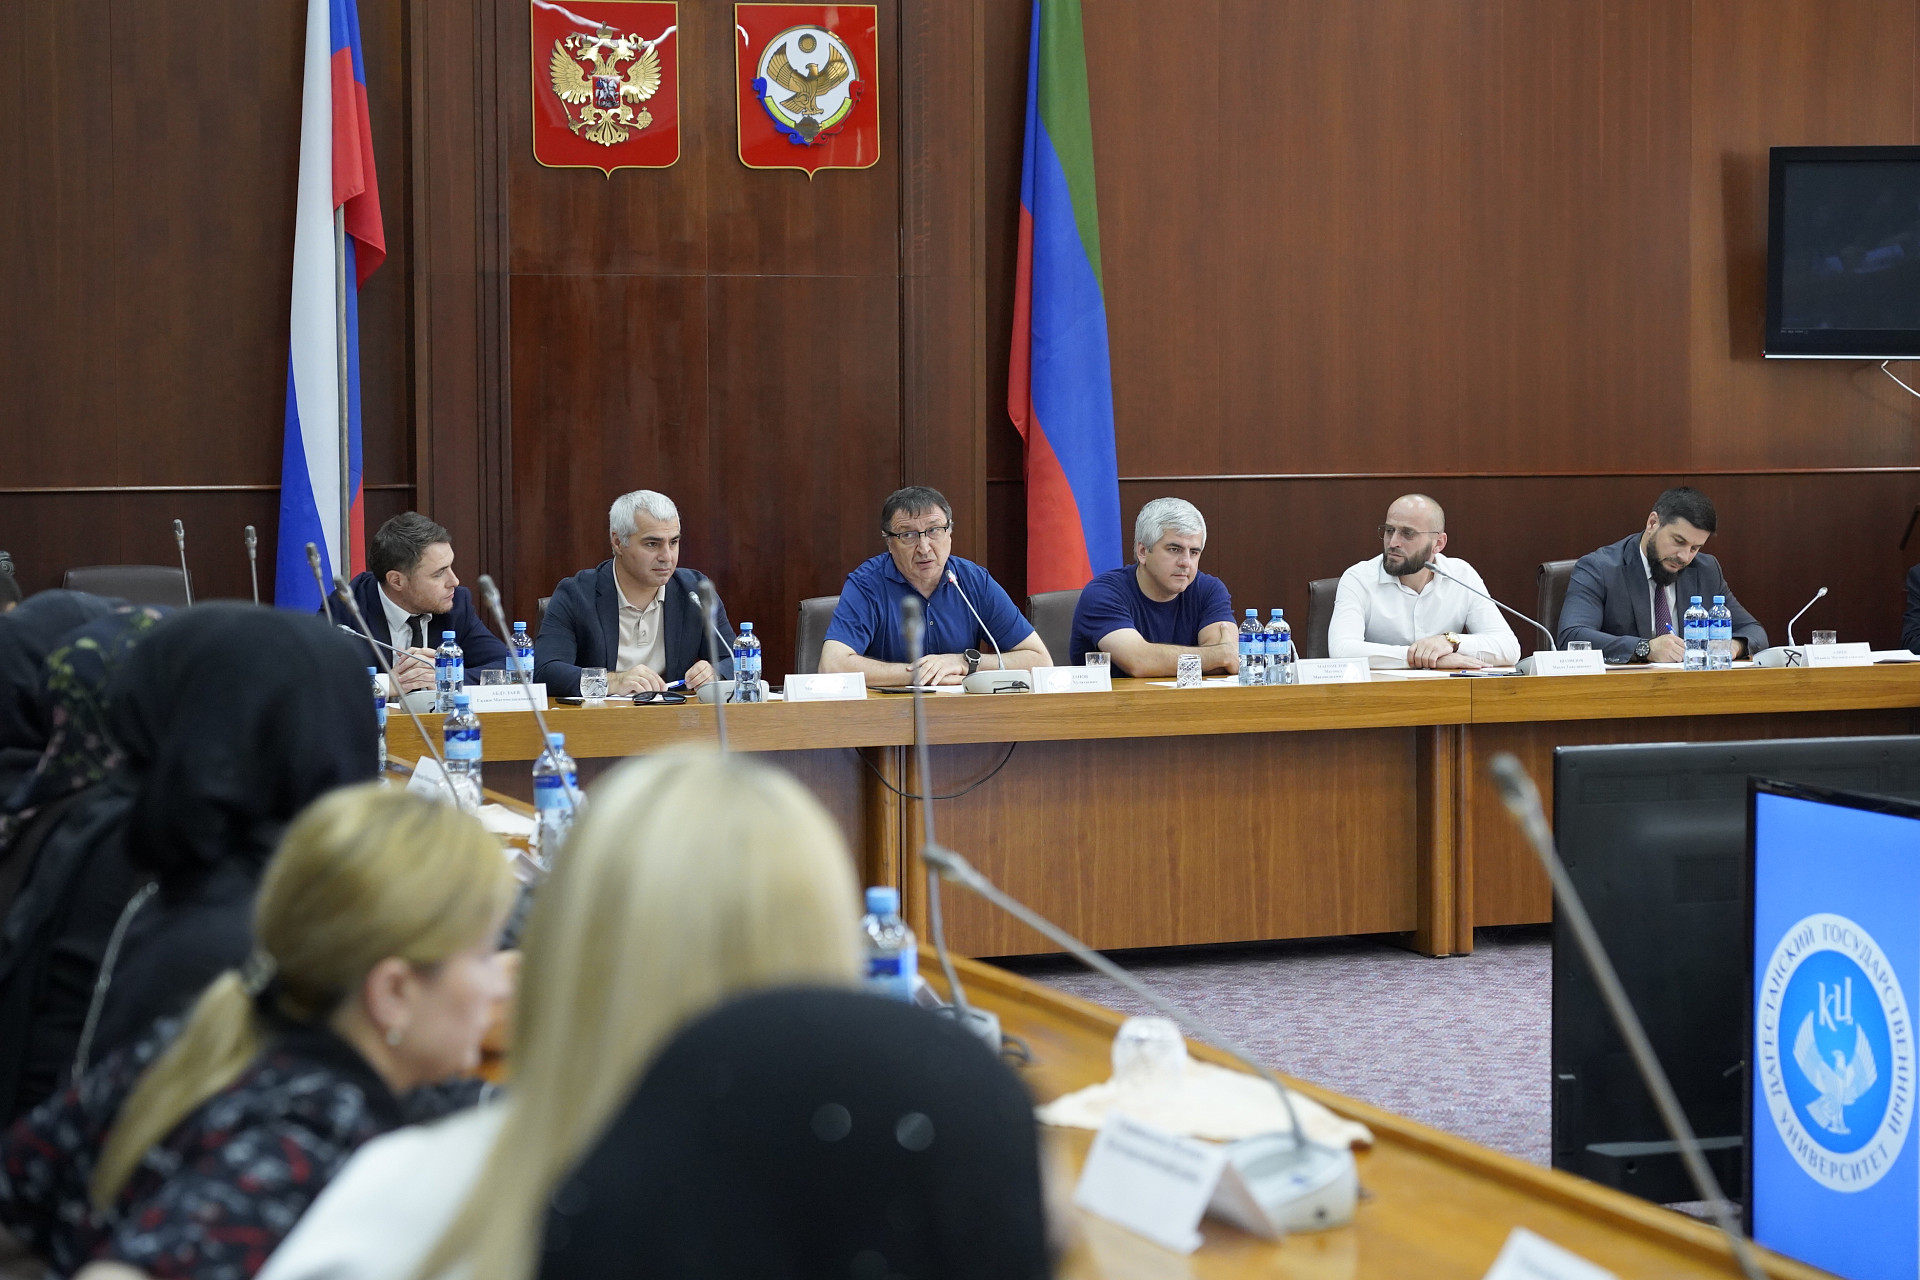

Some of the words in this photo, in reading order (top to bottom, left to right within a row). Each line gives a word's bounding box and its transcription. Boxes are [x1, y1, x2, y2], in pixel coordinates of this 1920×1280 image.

[1763, 925, 1815, 1097] ДАГЕСТАНСКИЙ
[1821, 922, 1909, 1136] ГОСУДАРСТВЕННЫЙ
[1779, 1110, 1889, 1183] УНИВЕРСИТЕТ
